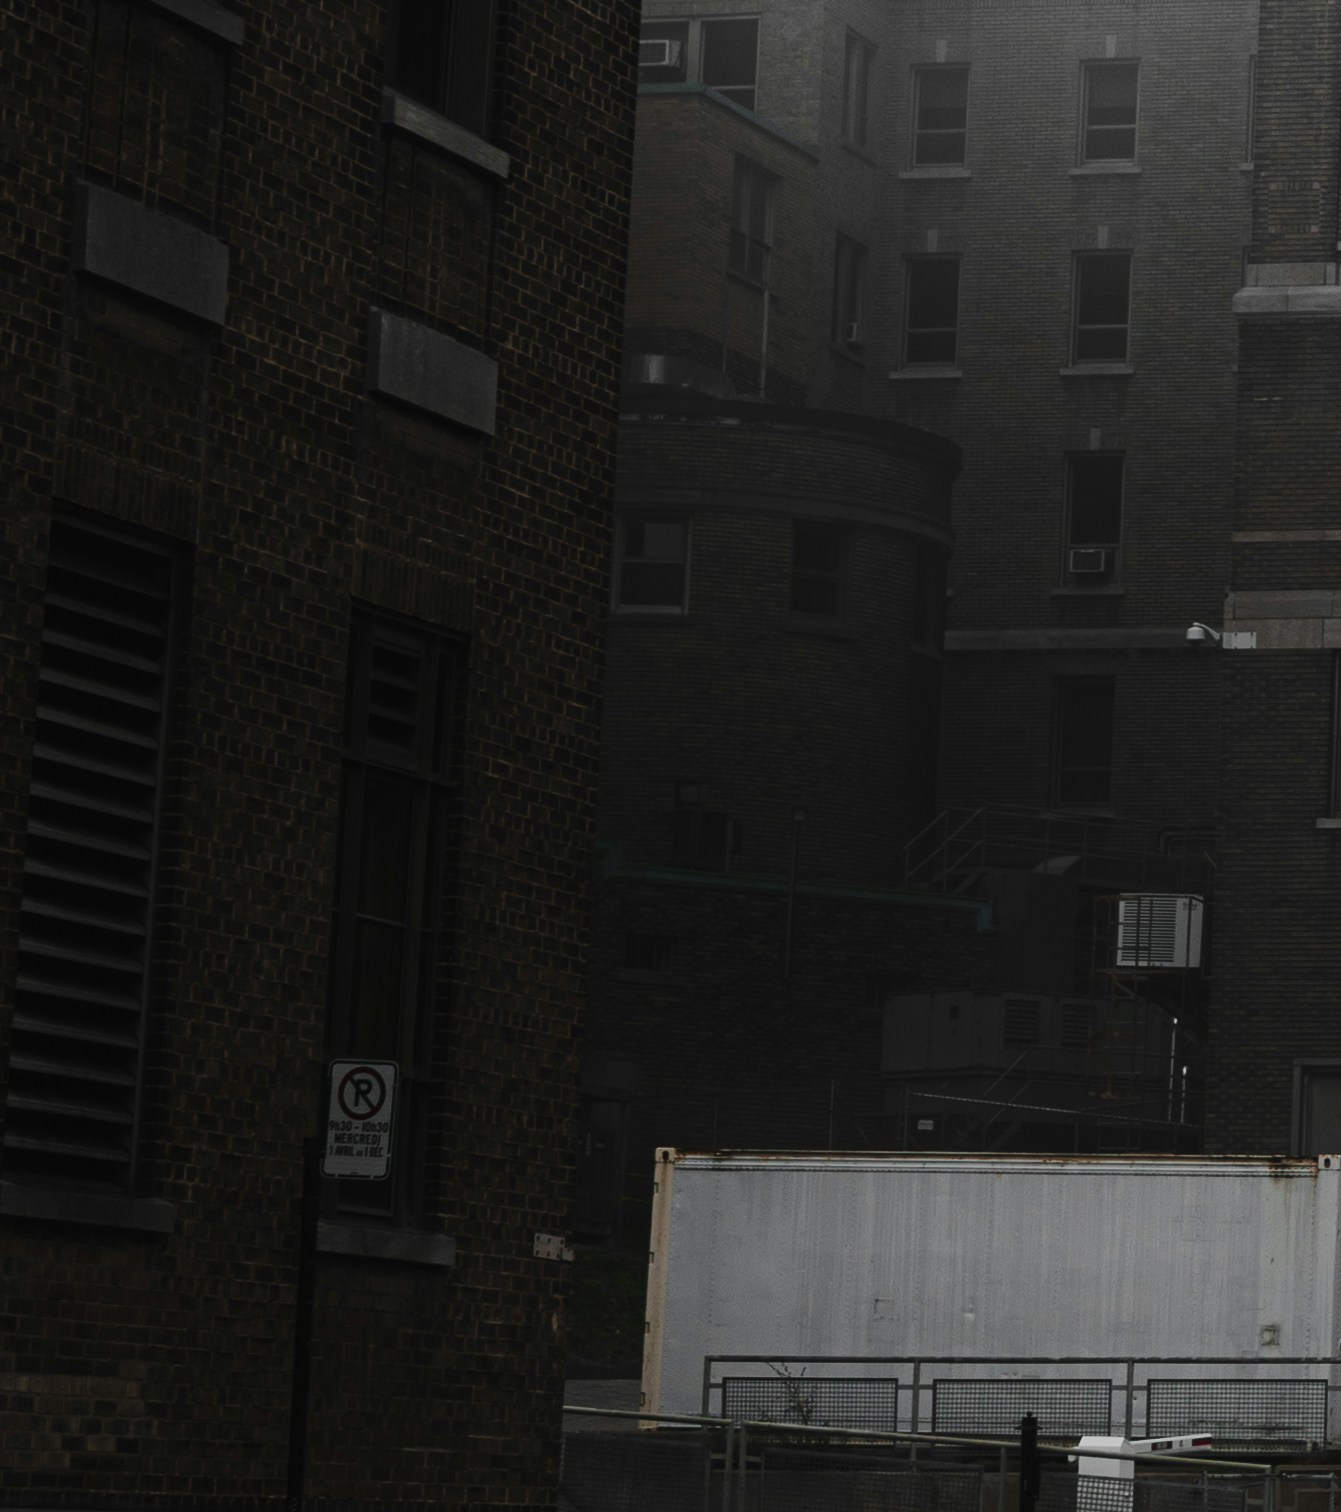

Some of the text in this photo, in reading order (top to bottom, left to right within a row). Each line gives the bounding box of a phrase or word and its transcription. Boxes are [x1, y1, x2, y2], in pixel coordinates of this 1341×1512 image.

[329, 1120, 353, 1132] 9h30
[362, 1121, 389, 1133] 10h30
[334, 1133, 382, 1145] MERCREDI
[335, 1145, 355, 1156] AVRIL
